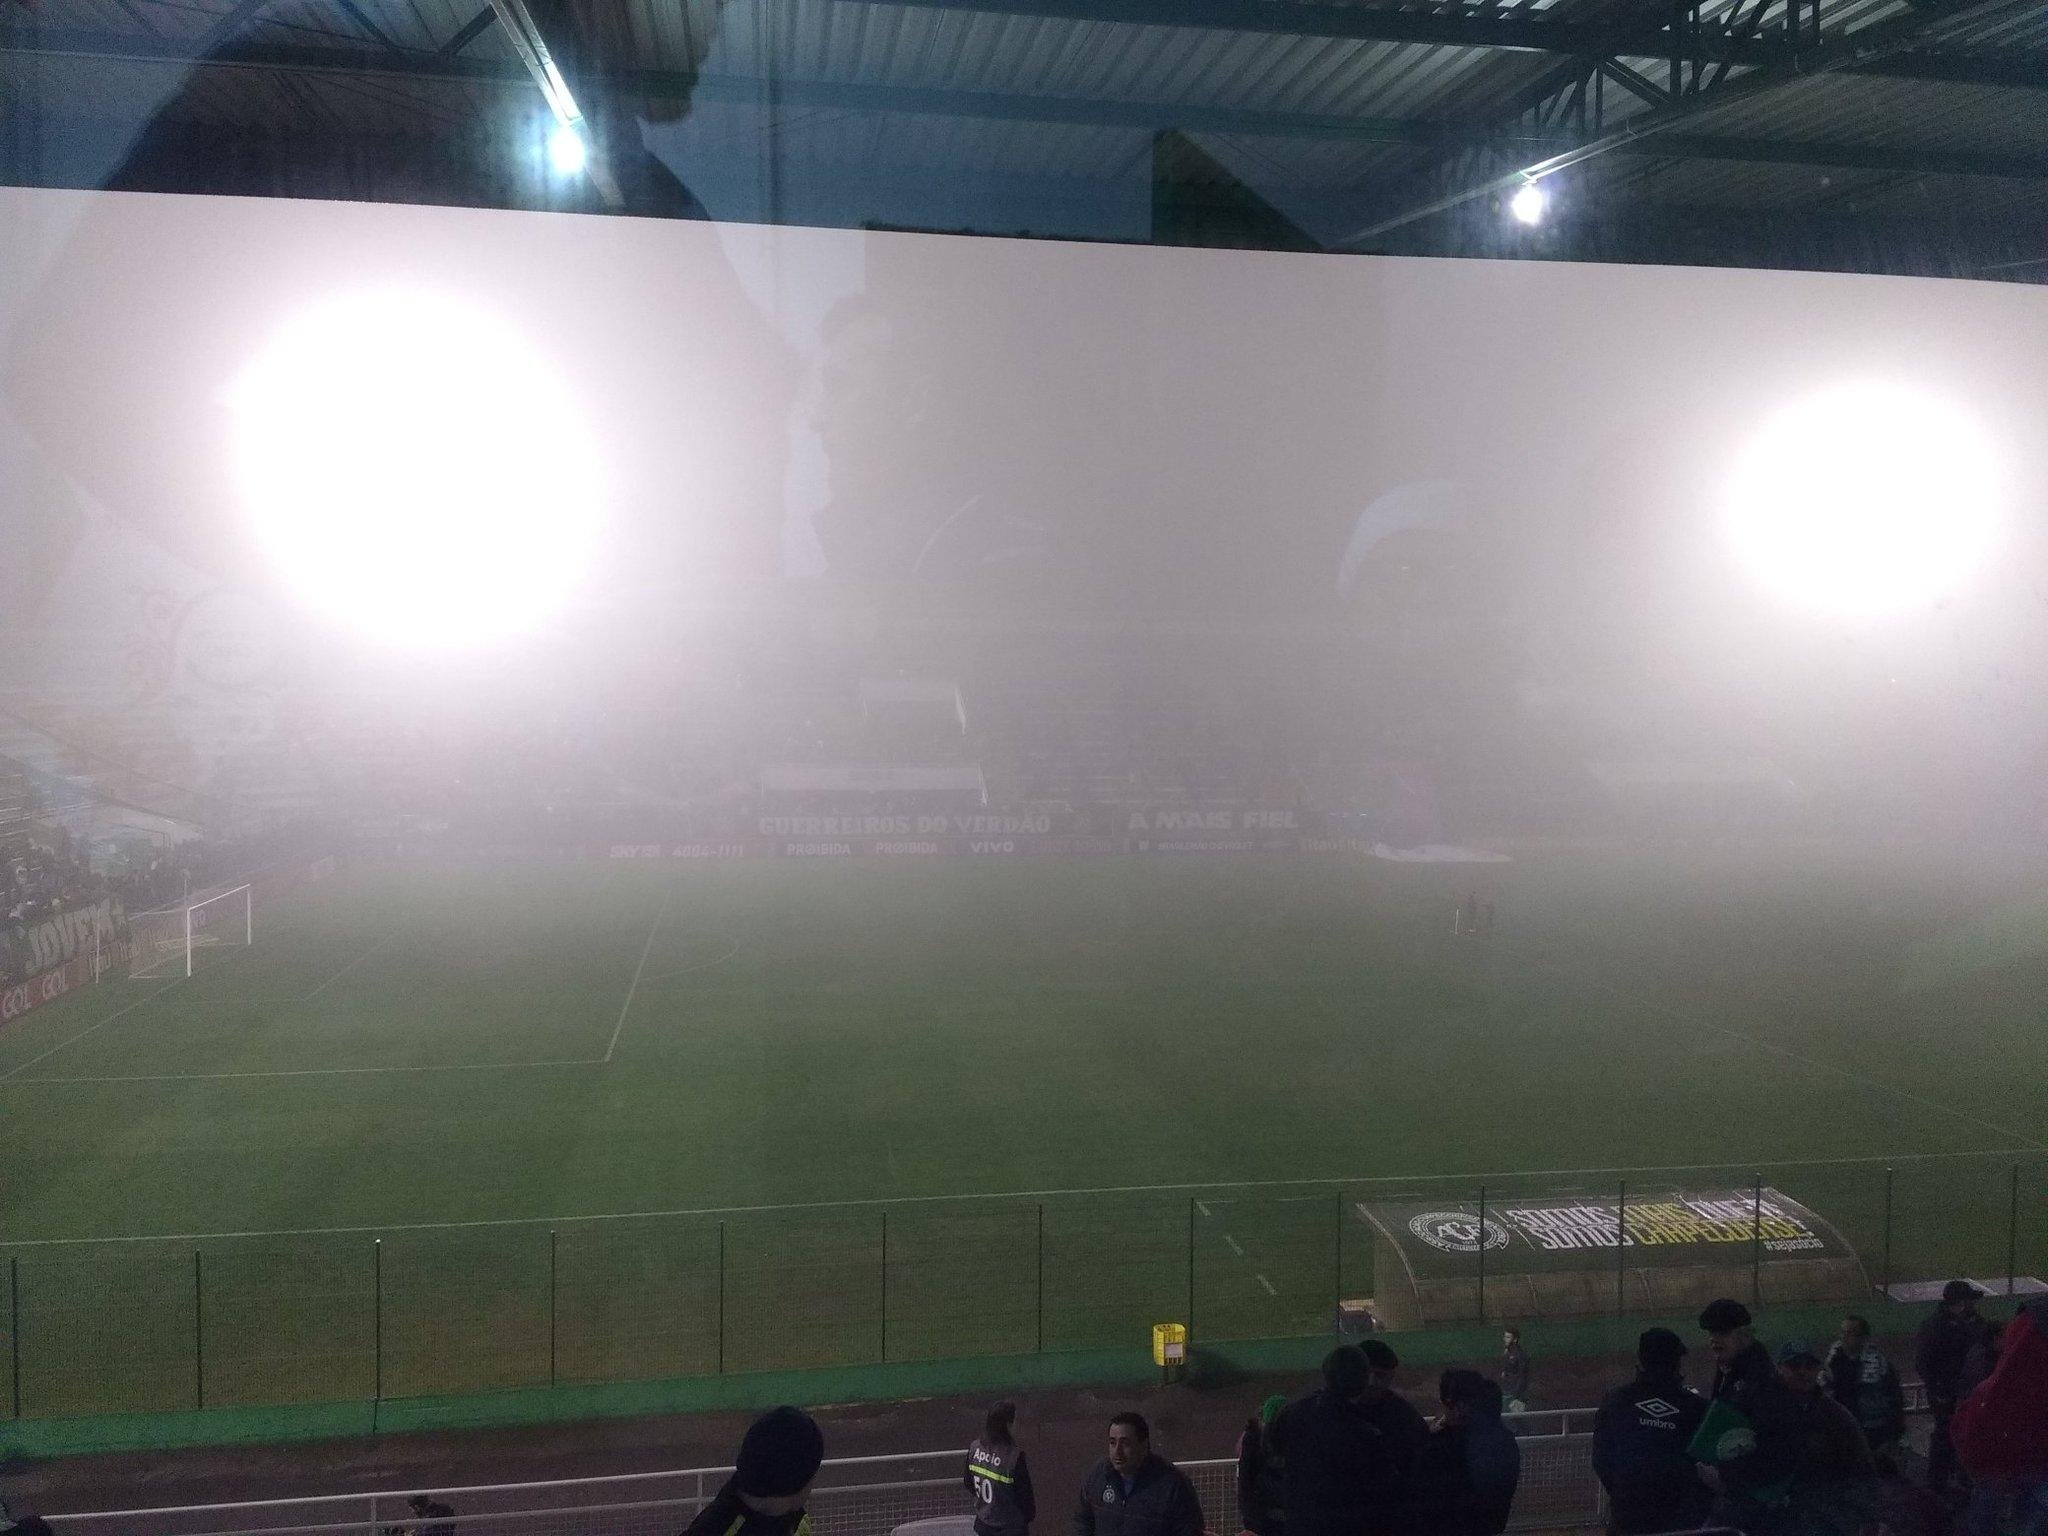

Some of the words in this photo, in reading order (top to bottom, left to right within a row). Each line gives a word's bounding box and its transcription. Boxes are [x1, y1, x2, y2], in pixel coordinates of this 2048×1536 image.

[758, 816, 911, 836] GUERREIROS
[917, 815, 949, 834] DO
[1128, 812, 1149, 831] A
[1155, 811, 1232, 830] MAIS
[1243, 810, 1299, 830] FIEL
[786, 843, 852, 856] PROIBIDA
[875, 841, 938, 855] PROIBIDA
[2, 983, 32, 1019] GOL
[1506, 1206, 1620, 1228] SOMOS
[973, 1448, 1001, 1466] Apoio
